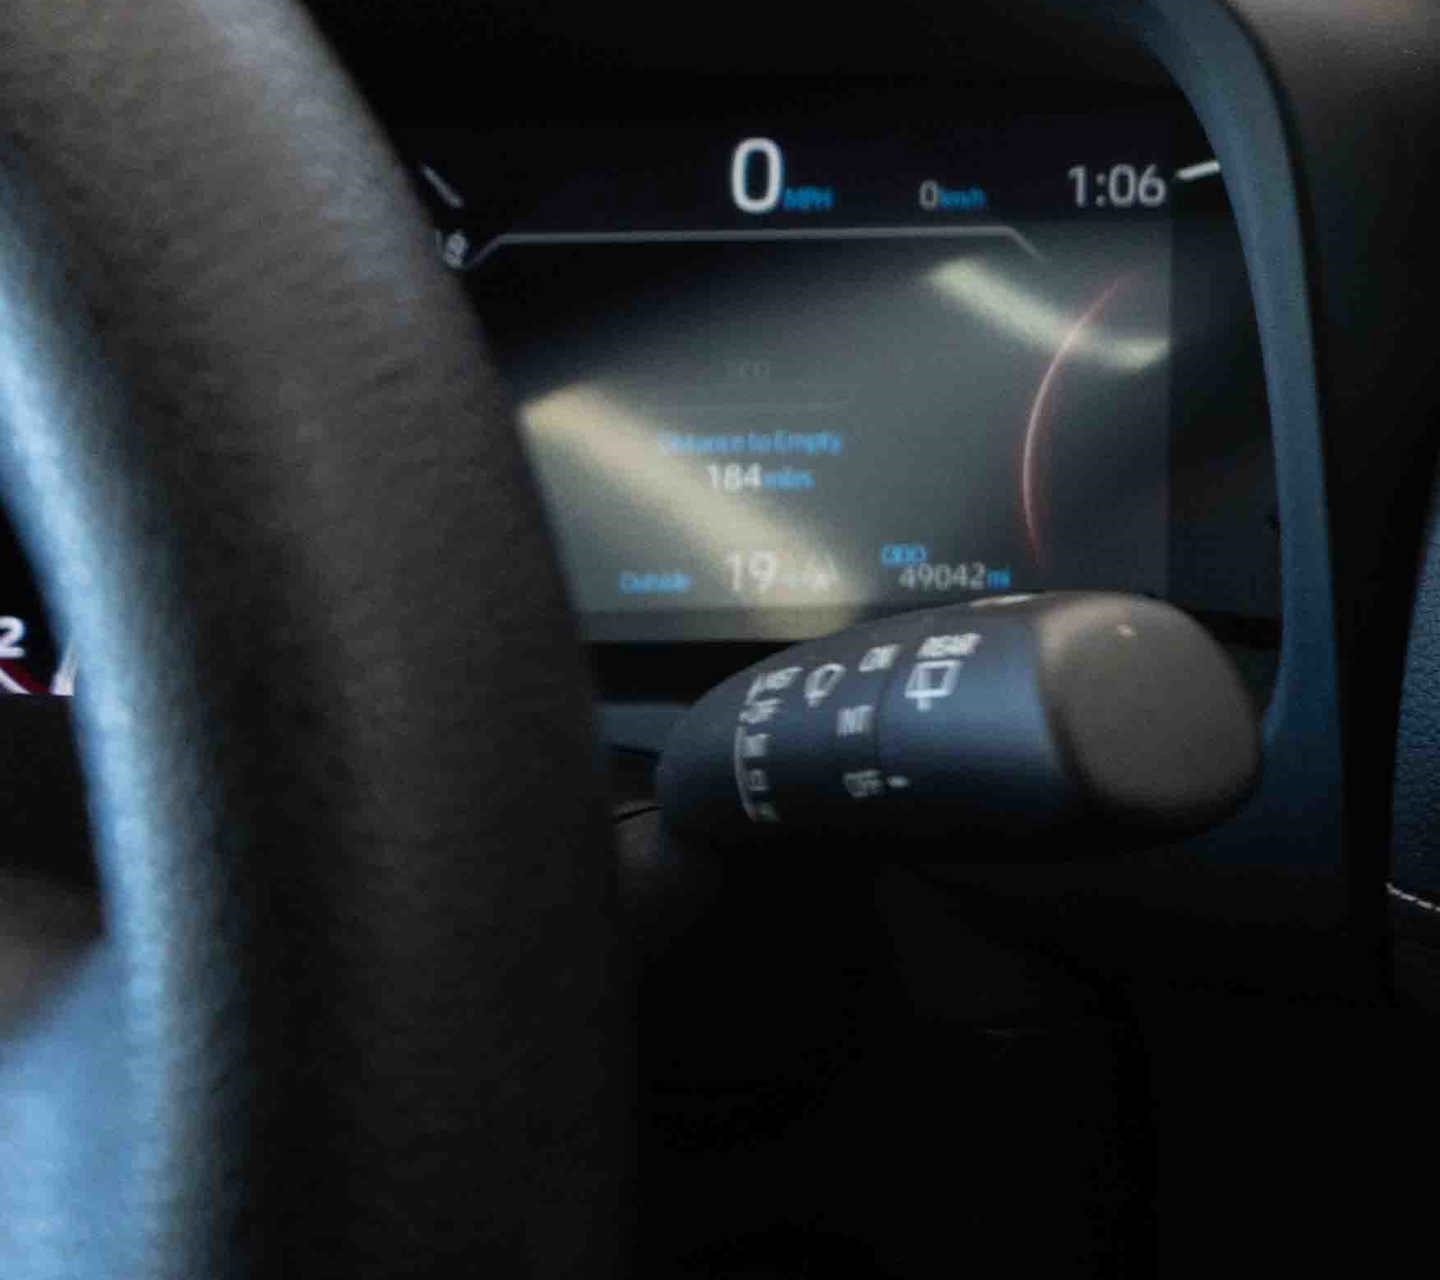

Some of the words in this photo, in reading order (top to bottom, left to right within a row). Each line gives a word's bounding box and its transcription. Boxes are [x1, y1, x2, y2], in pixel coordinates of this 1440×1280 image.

[731, 137, 784, 214] 0
[1069, 165, 1167, 208] 1:06
[919, 180, 939, 210] 0
[708, 463, 762, 492] 184
[899, 562, 985, 591] 49042
